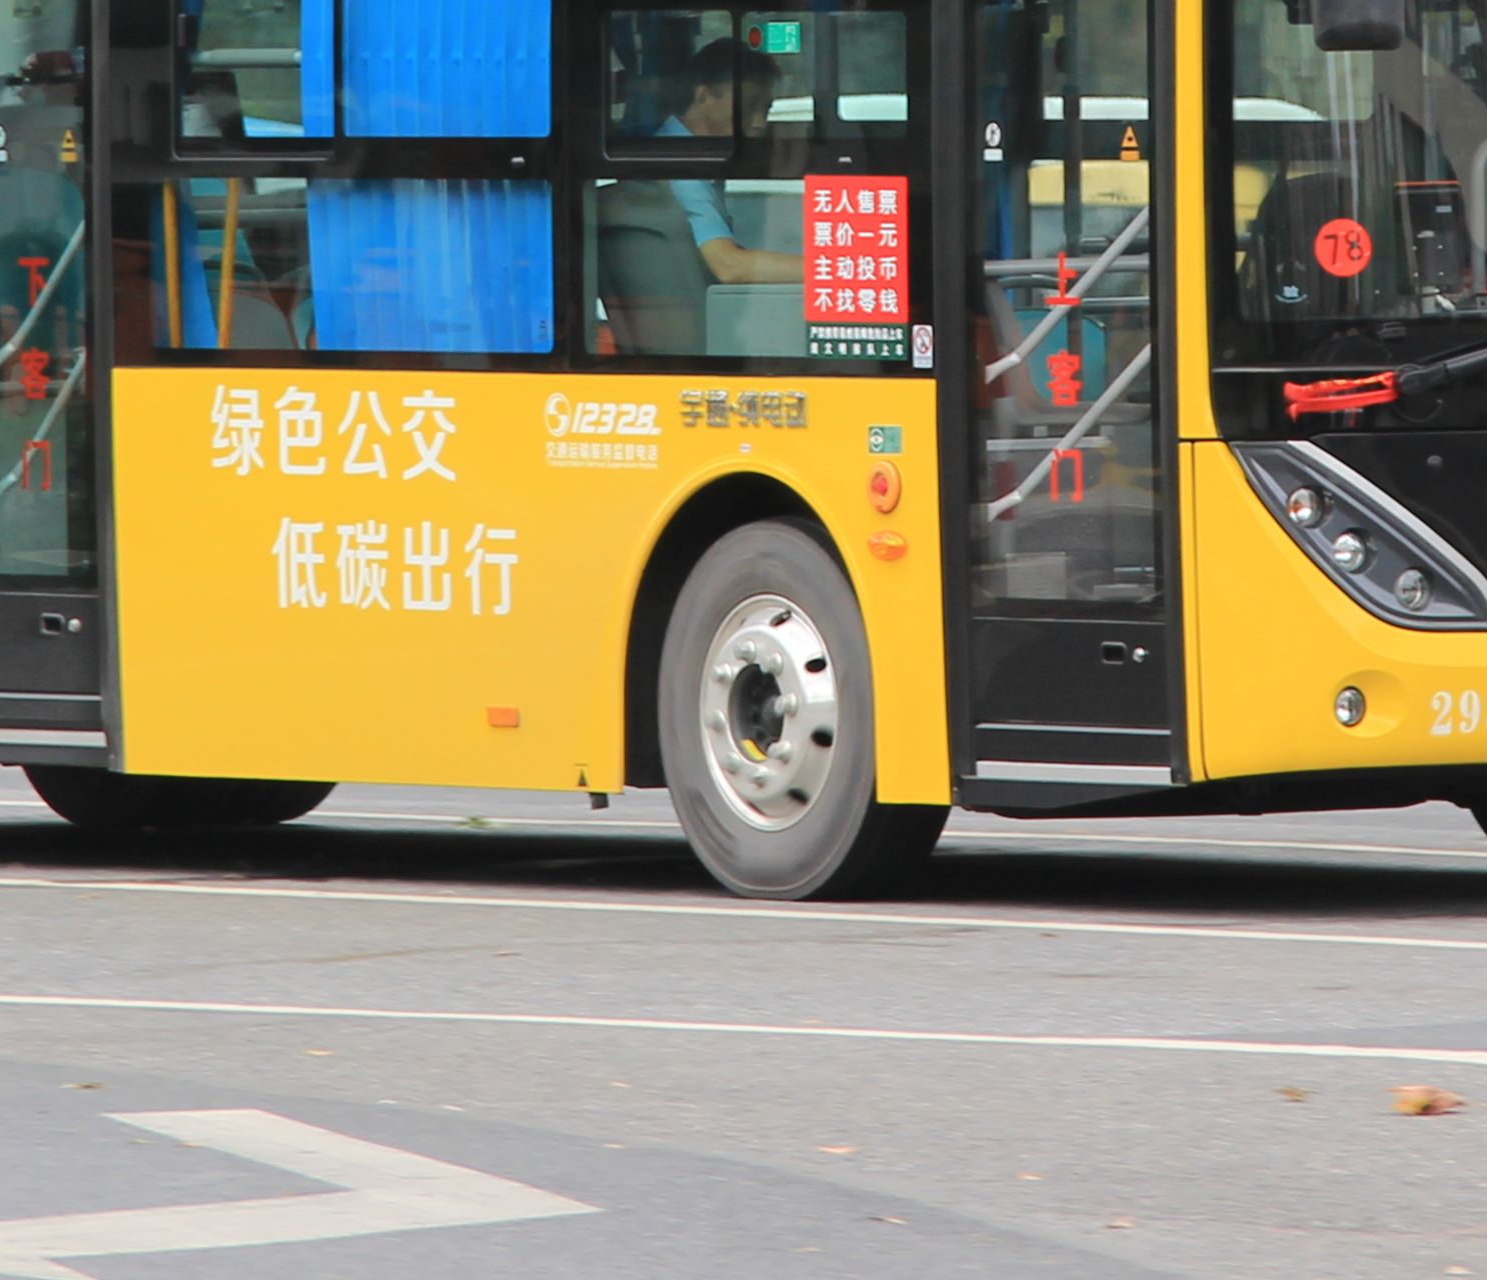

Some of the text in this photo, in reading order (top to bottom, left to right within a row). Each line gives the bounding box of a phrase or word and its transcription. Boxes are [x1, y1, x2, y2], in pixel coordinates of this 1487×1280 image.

[813, 189, 898, 215] 无人售票
[813, 222, 898, 247] 票价一元
[1323, 230, 1363, 266] 78
[813, 255, 899, 280] 主动投币
[813, 288, 899, 313] 不找零钱
[1044, 251, 1084, 503] 上客门
[210, 384, 457, 483] 绿色公交
[571, 402, 662, 435] 12328
[271, 517, 519, 616] 低碳出行
